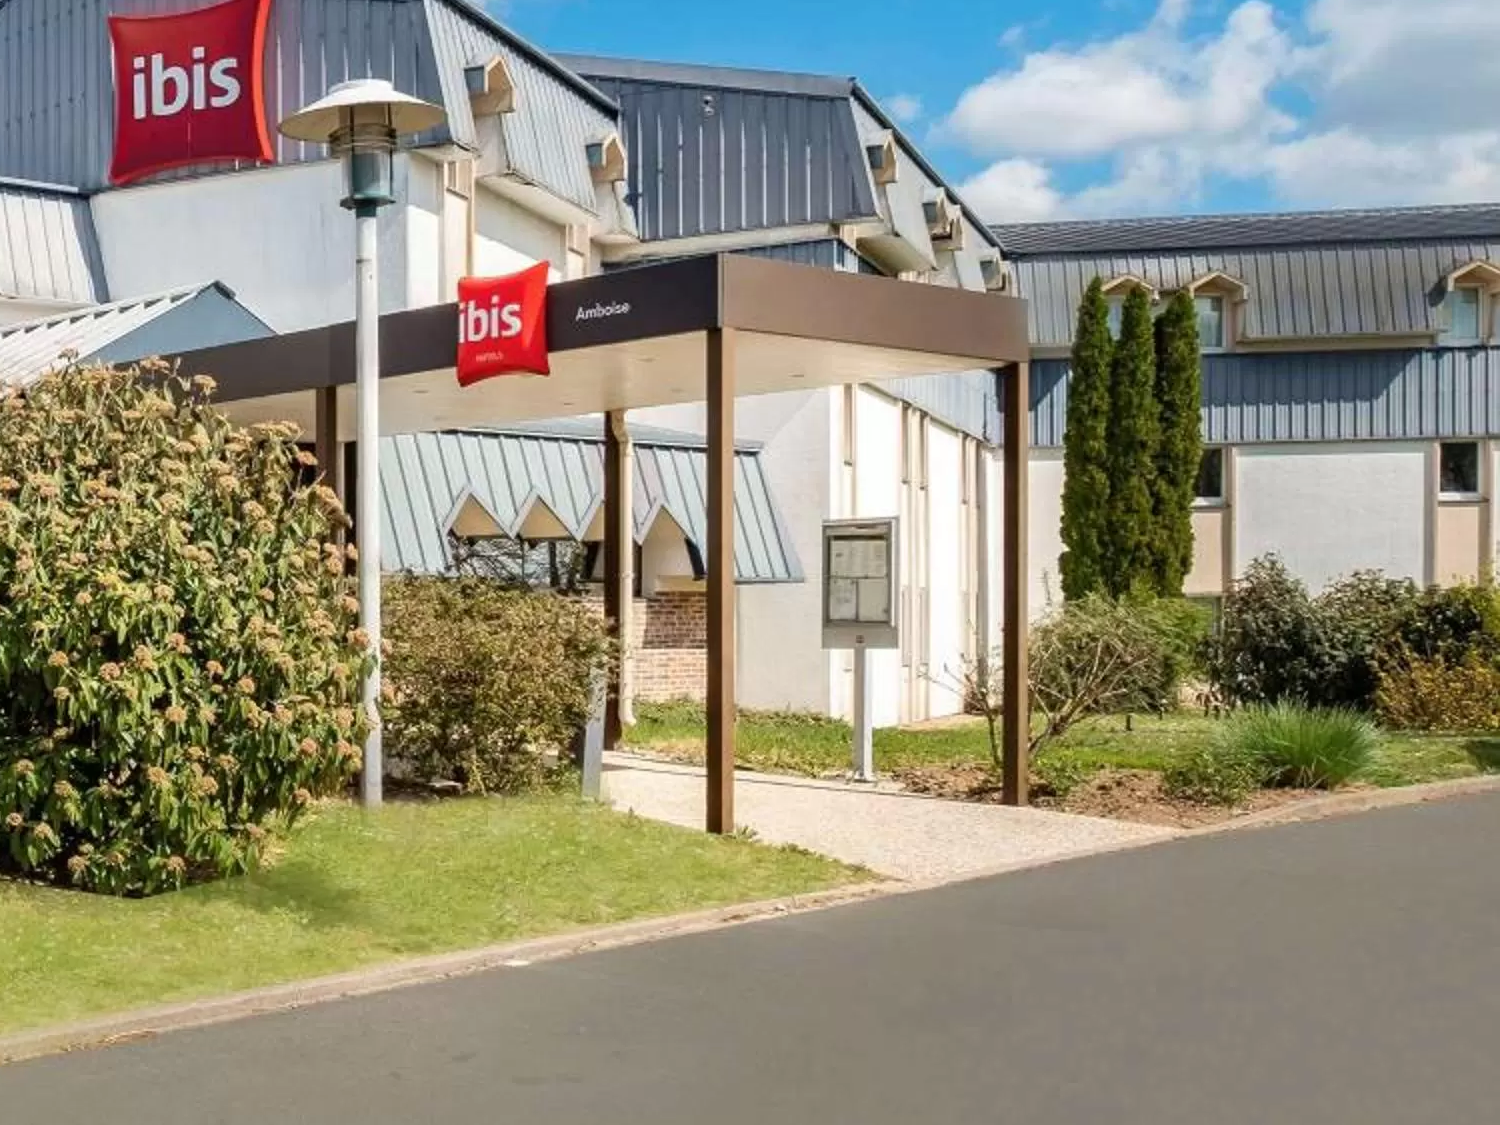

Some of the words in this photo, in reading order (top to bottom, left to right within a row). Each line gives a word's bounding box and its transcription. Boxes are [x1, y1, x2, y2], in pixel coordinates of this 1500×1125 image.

[133, 46, 241, 120] ibis
[458, 294, 522, 344] ibis
[575, 301, 632, 322] Amboise
